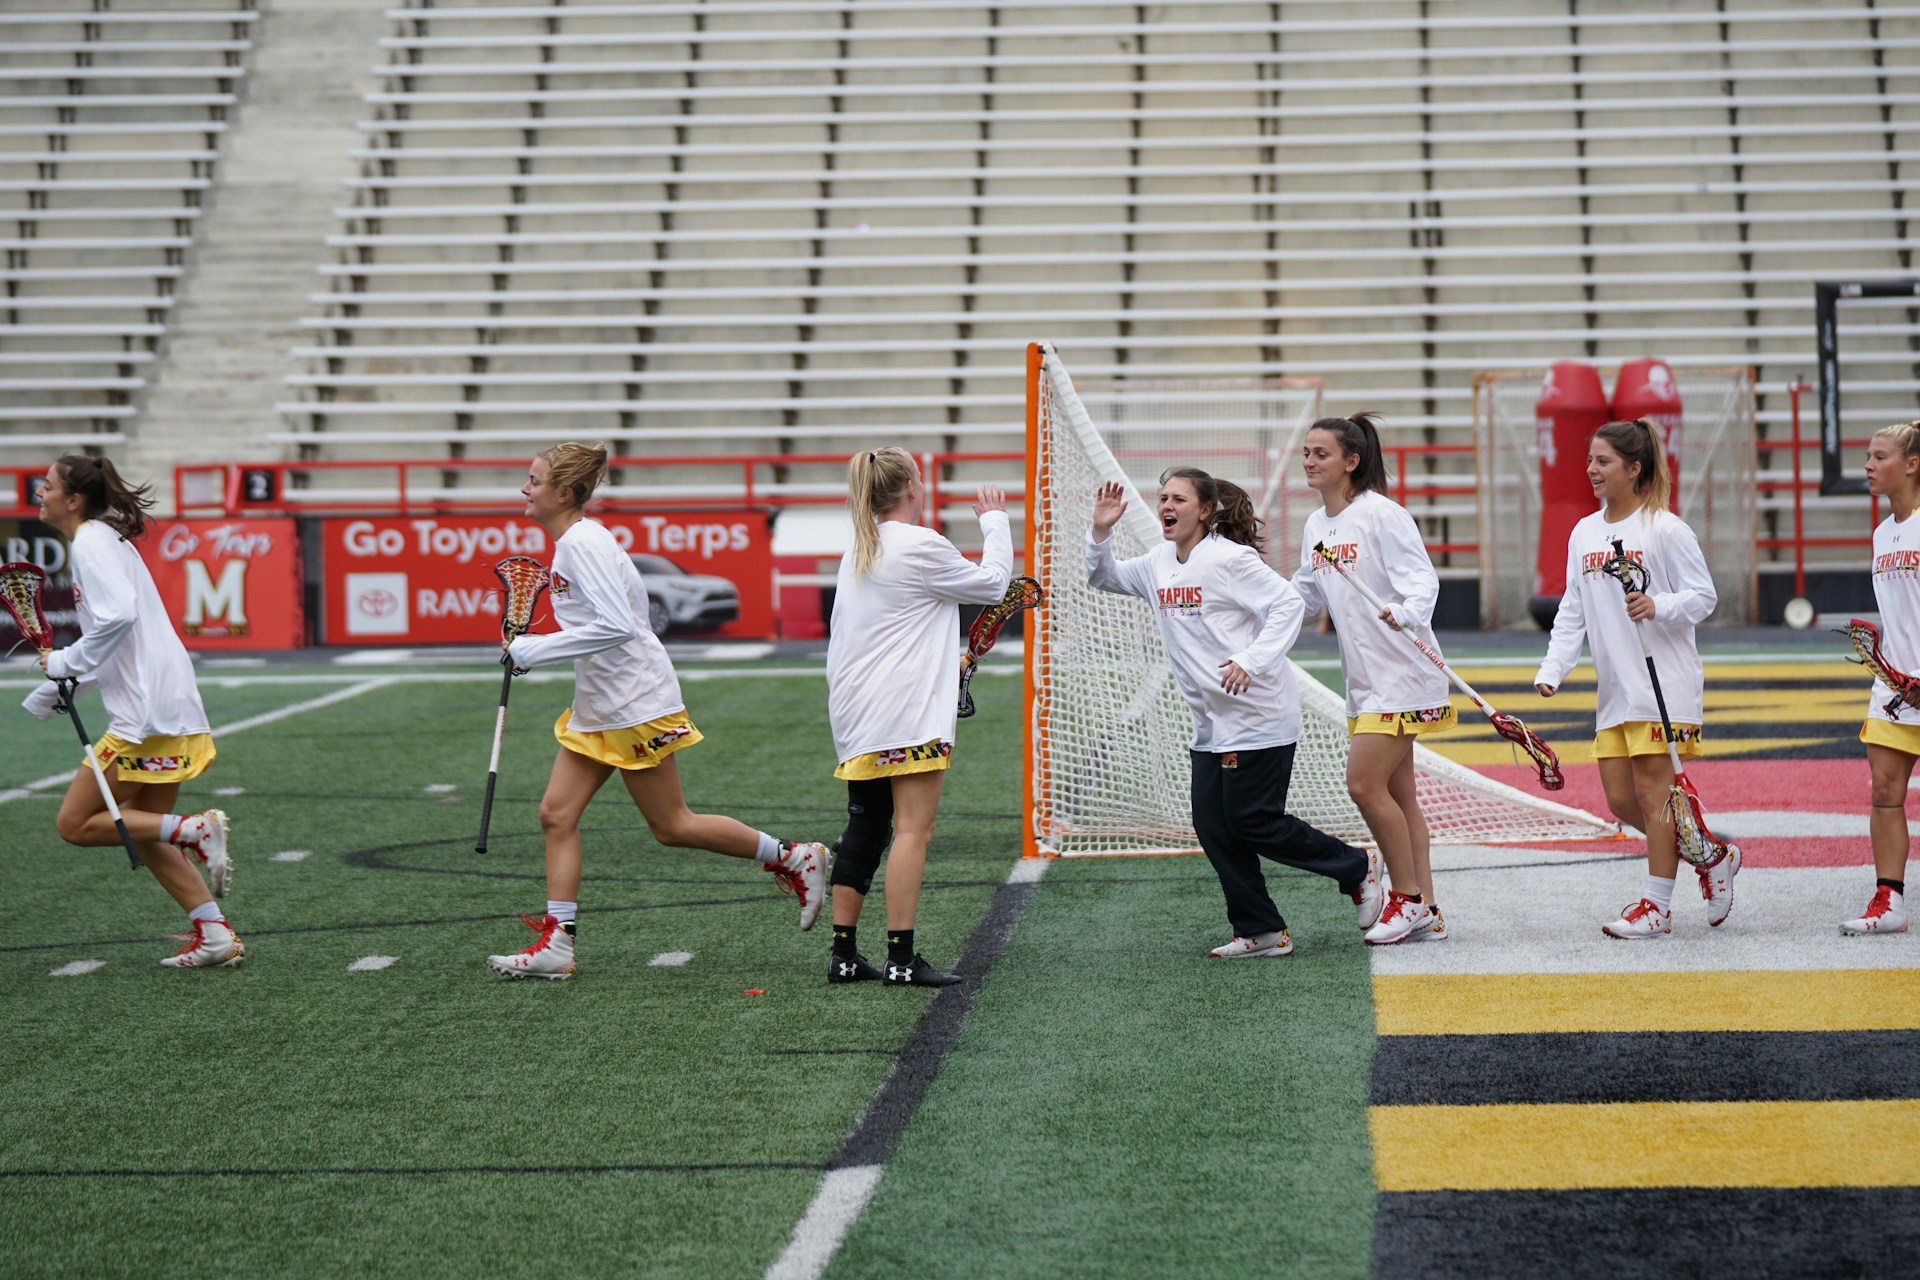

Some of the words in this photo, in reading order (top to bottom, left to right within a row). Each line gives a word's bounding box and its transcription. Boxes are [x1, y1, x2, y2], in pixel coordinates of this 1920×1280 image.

[0, 537, 73, 574] RD
[160, 523, 199, 562] Go
[342, 520, 405, 557] Go
[411, 519, 546, 564] Toyota
[640, 516, 750, 560] Terps
[183, 557, 249, 626] M
[416, 588, 502, 617] RAV4
